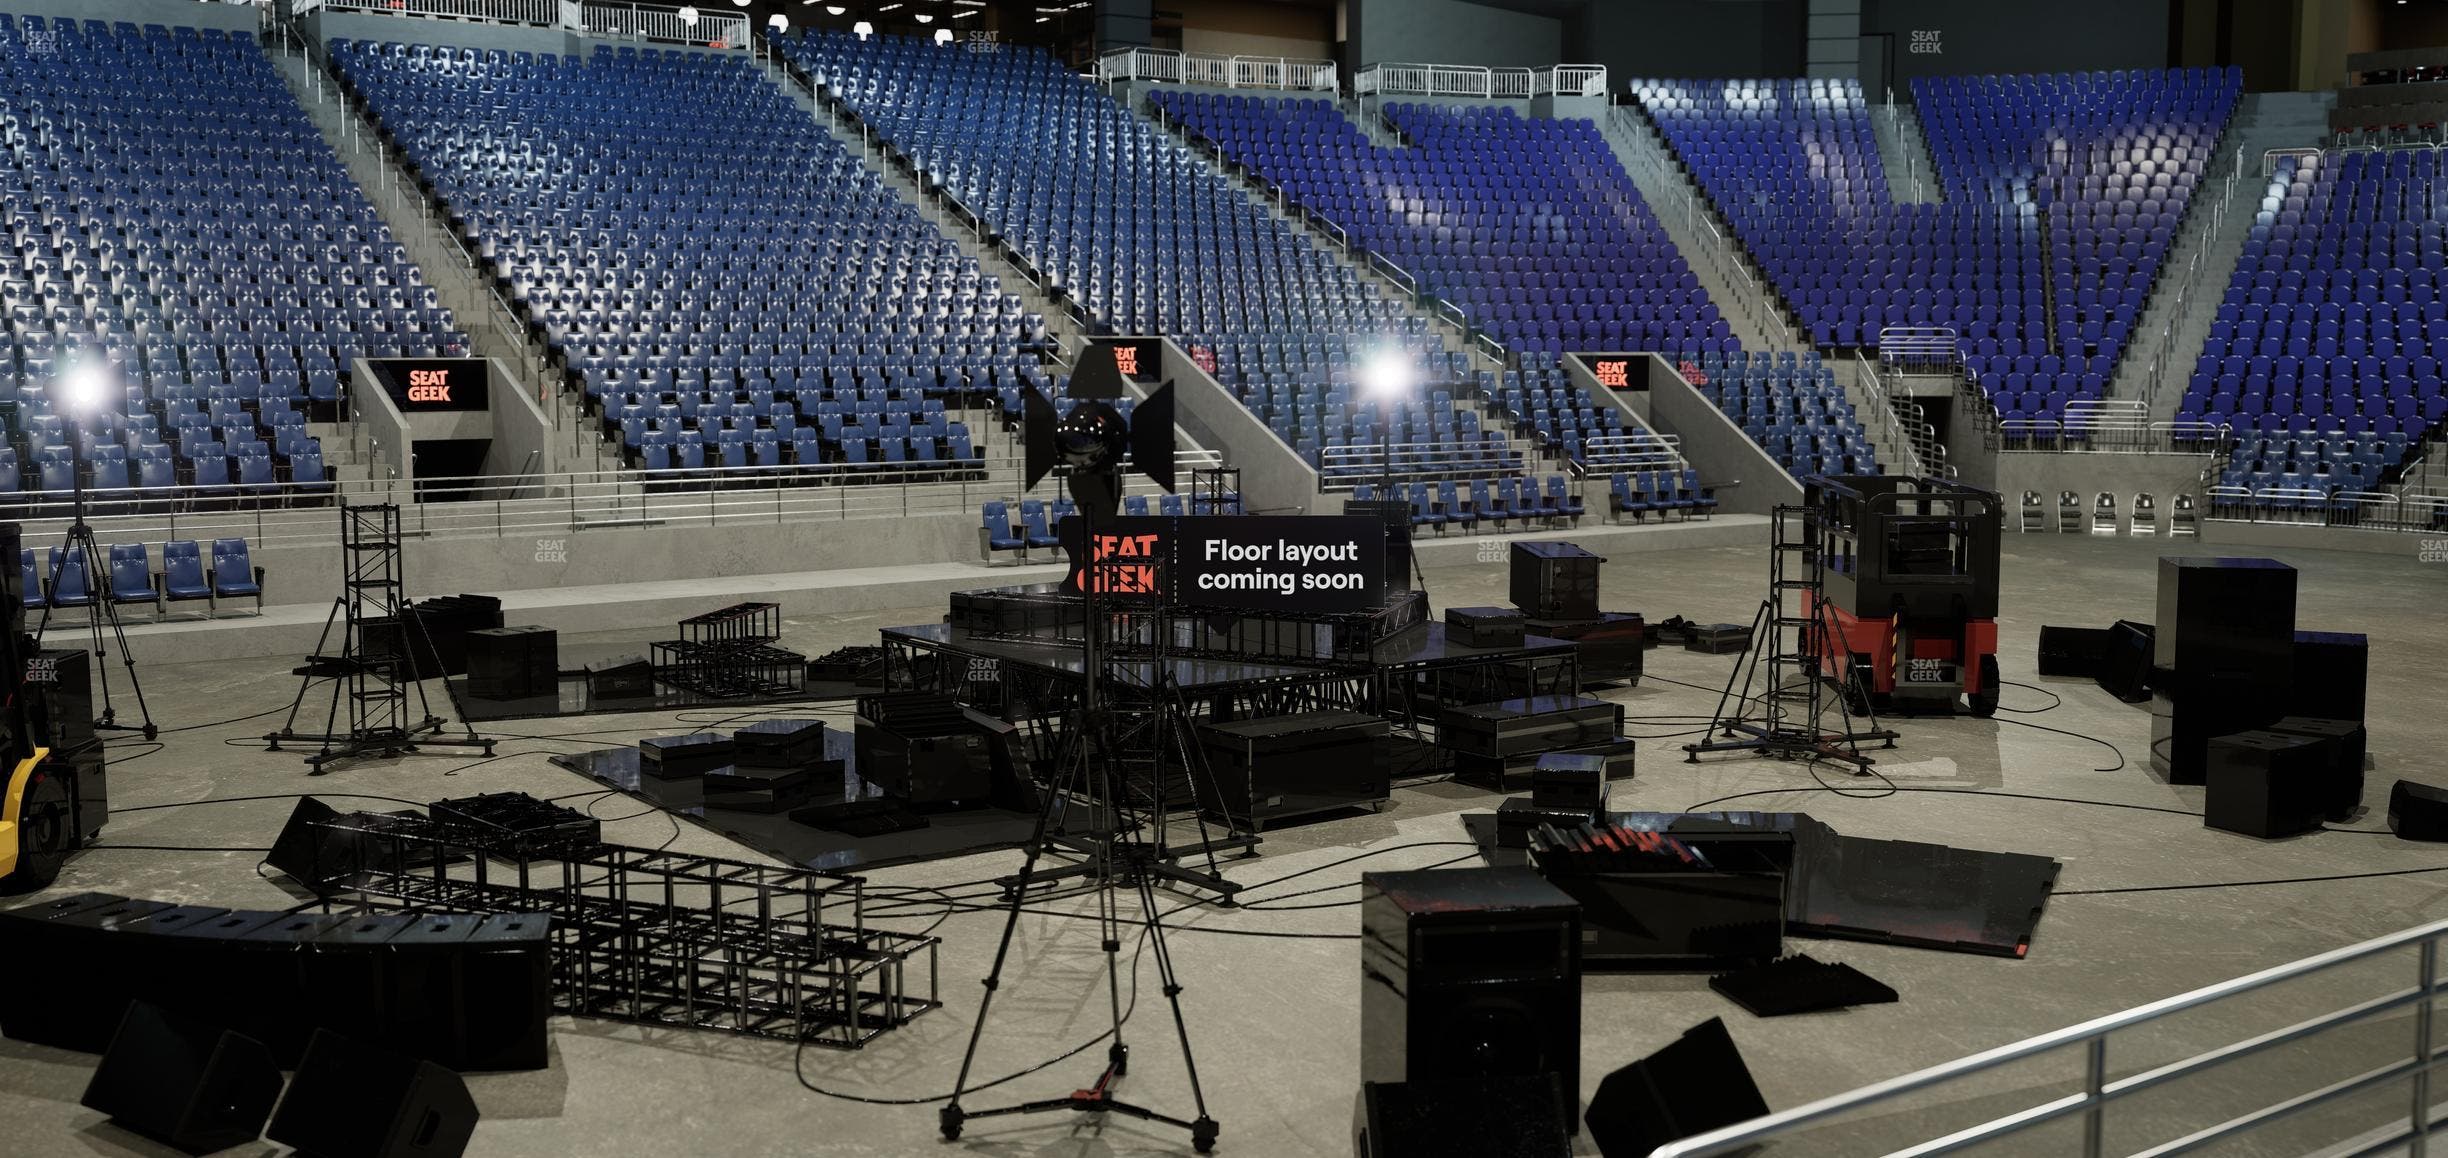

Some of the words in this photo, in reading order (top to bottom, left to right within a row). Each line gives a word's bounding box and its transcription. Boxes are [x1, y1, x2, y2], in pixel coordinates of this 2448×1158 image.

[1118, 360, 1138, 375] EEK
[1596, 361, 1628, 374] SEAT
[409, 370, 449, 386] SEAT
[408, 385, 452, 402] GEEK
[1205, 540, 1273, 561] Floor
[1279, 539, 1359, 566] layout
[1198, 568, 1296, 596] coming
[1302, 572, 1364, 590] soon
